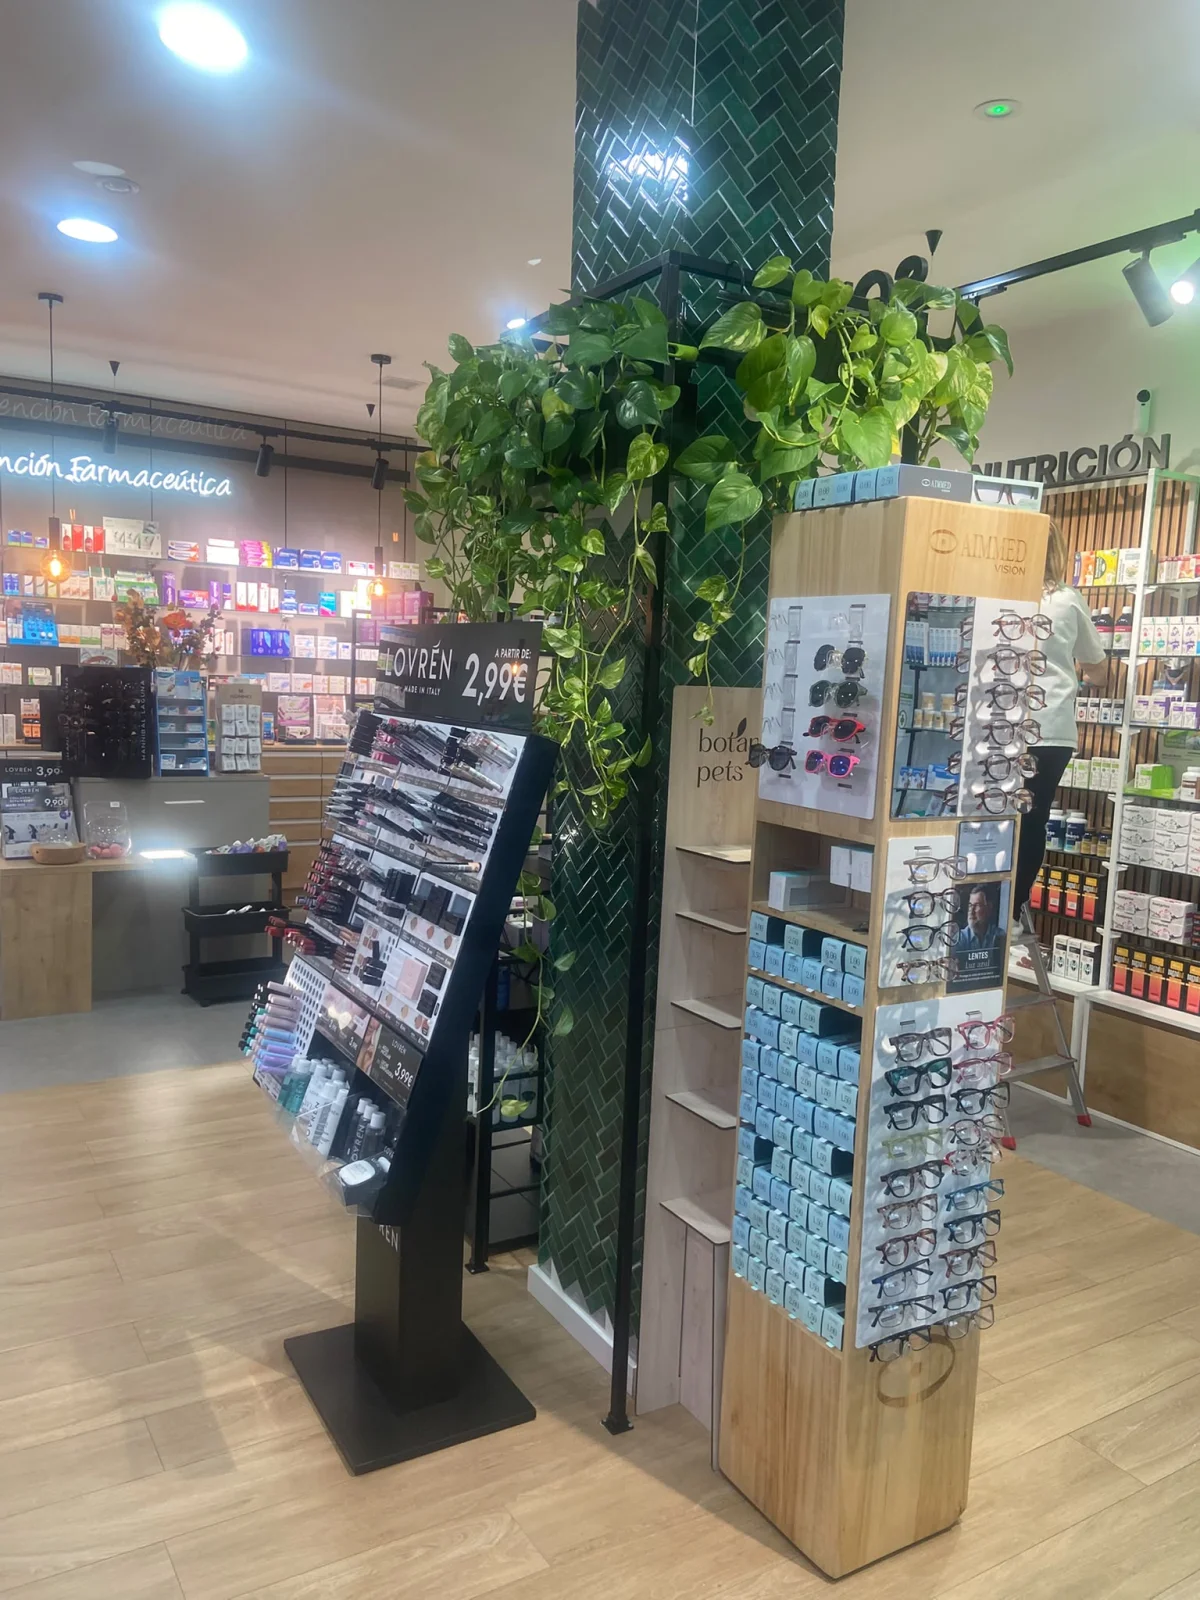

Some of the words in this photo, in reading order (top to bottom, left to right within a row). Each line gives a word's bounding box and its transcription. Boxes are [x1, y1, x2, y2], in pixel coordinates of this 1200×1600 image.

[961, 533, 1027, 563] AIMMED
[994, 564, 1026, 577] VISION
[385, 640, 452, 680] LOVRÉN
[495, 648, 499, 657] A
[501, 649, 519, 659] PARTIR
[404, 685, 417, 693] MADE
[419, 686, 424, 694] IN
[426, 687, 440, 696] ITALY
[462, 653, 528, 706] 2,99€
[697, 761, 743, 788] pets
[968, 951, 989, 961] LENTES
[394, 1062, 413, 1087] 3,99€
